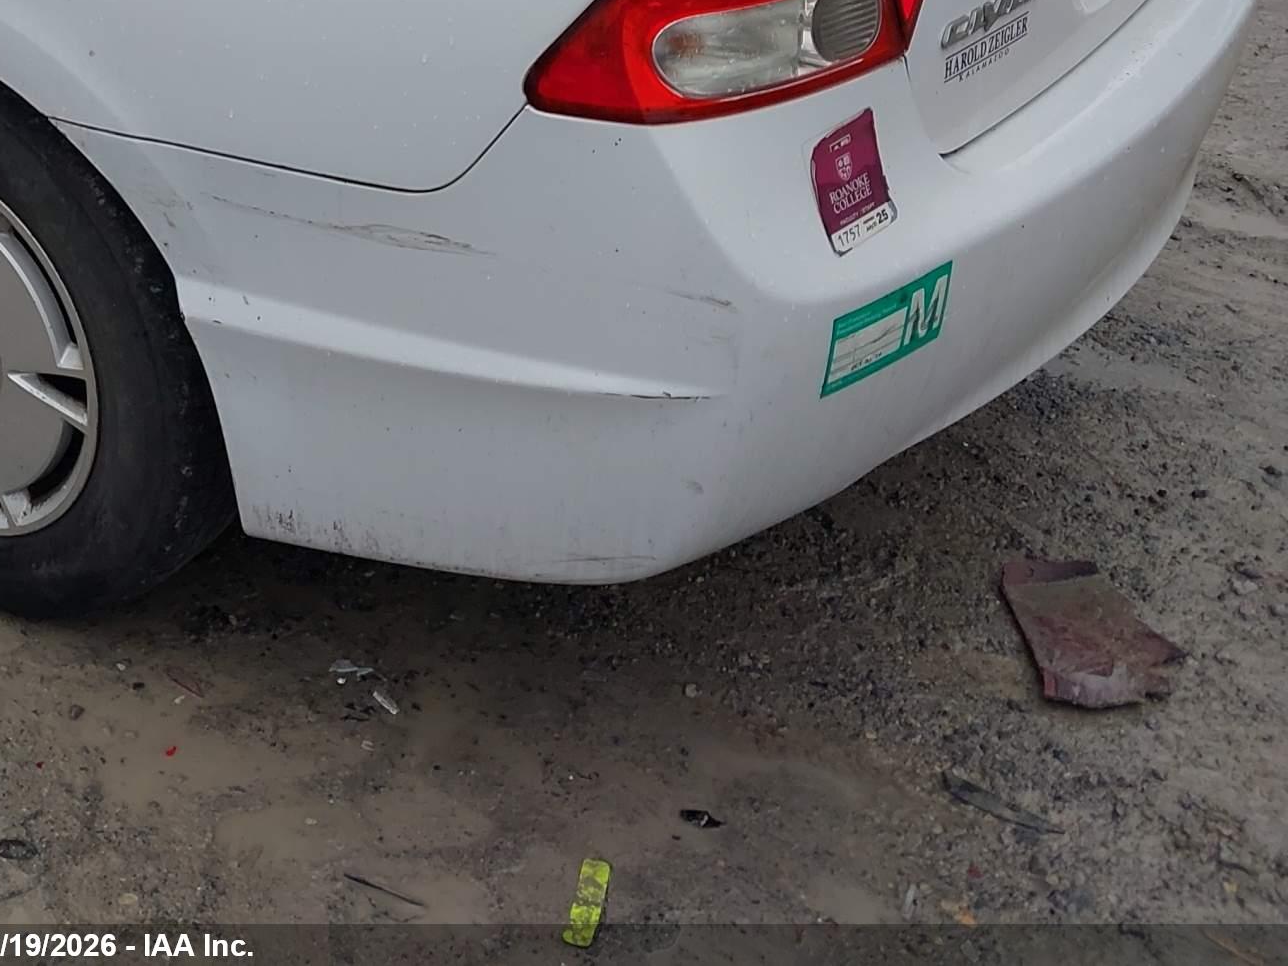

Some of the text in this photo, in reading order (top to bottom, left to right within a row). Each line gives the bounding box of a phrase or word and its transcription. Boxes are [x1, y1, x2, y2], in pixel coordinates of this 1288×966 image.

[944, 17, 1028, 80] HAROLD ZEIGLER
[829, 172, 871, 205] ROANOKE
[833, 184, 872, 214] COLLEGE
[837, 223, 861, 247] 1757
[876, 209, 889, 225] 25
[903, 274, 948, 346] M
